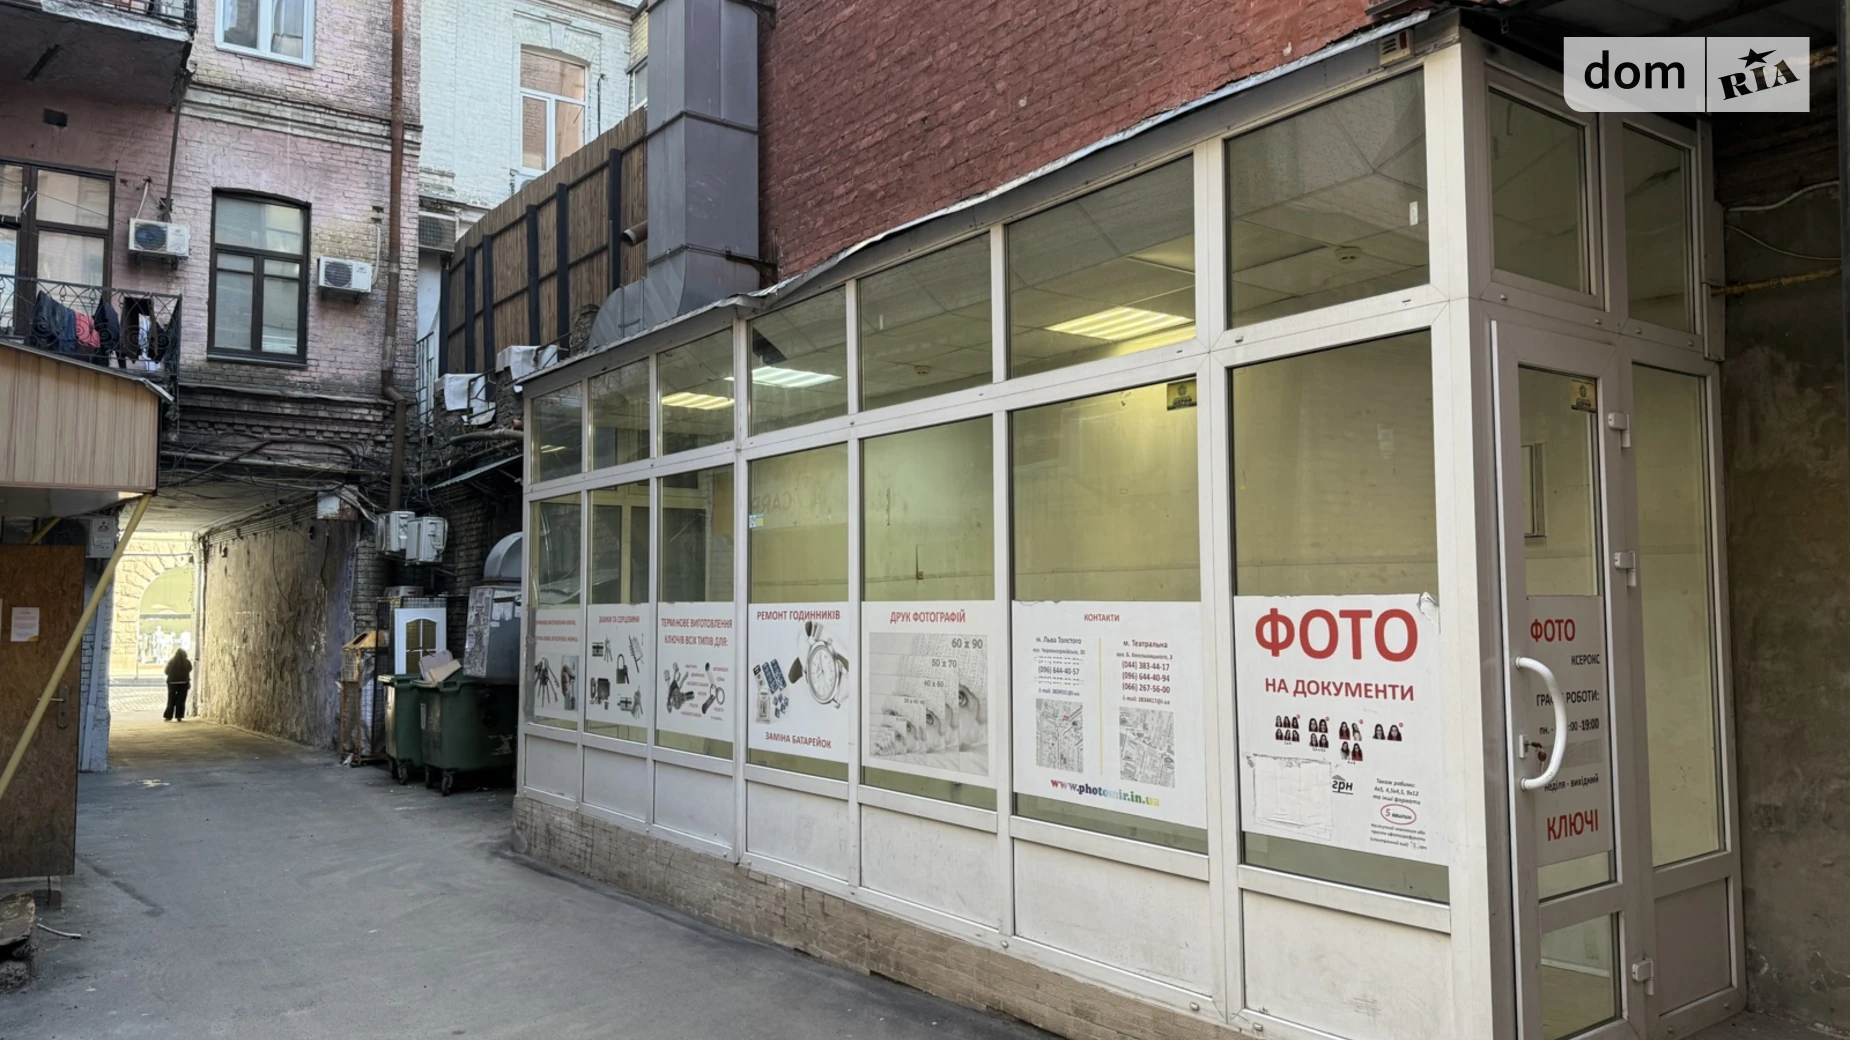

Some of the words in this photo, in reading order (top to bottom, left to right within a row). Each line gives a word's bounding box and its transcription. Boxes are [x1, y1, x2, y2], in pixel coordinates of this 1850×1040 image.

[757, 611, 788, 621] РЕМОНТ
[789, 610, 841, 621] ГОДИННИКІВ
[890, 611, 911, 624] ДРУК
[913, 609, 966, 623] ФОТОГРАФІЙ
[1084, 614, 1120, 622] КОНТАКТИ
[661, 618, 690, 628] ТЕРМІНОВЕ
[691, 619, 732, 628] ВИГОТОВЛЕННЯ
[1254, 608, 1418, 662] ФОТО
[1530, 618, 1576, 643] ФОТО
[664, 635, 685, 645] КЛЮЧІВ
[685, 636, 697, 645] ВСІХ
[698, 636, 713, 646] ТИПІВ
[714, 637, 728, 647] ДЛЯ:
[952, 638, 962, 648] 60
[972, 639, 983, 649] 90
[1132, 639, 1168, 649] Театральна
[932, 659, 941, 667] 50
[948, 659, 957, 668] 70
[1571, 653, 1600, 666] КСЕРОКС
[1038, 666, 1052, 674] (096)
[1053, 667, 1080, 675] 644-40-57
[1122, 660, 1137, 670] (044)
[1139, 662, 1169, 671] 383-44-17
[1122, 672, 1137, 681] (096)
[1139, 673, 1170, 682] 644-40-94
[1122, 682, 1137, 692] (066)
[1139, 684, 1170, 693] 267-56-00
[1265, 677, 1288, 693] НА
[1293, 679, 1414, 701] ДОКУМЕНТИ
[1566, 690, 1600, 704] РОБОТИ:
[766, 732, 791, 743] ЗАМІНА
[792, 734, 832, 748] БАТАРЕЙОК
[1571, 775, 1599, 789] вихідний
[1385, 808, 1391, 817] 5
[1547, 809, 1599, 841] КЛЮЧІ
